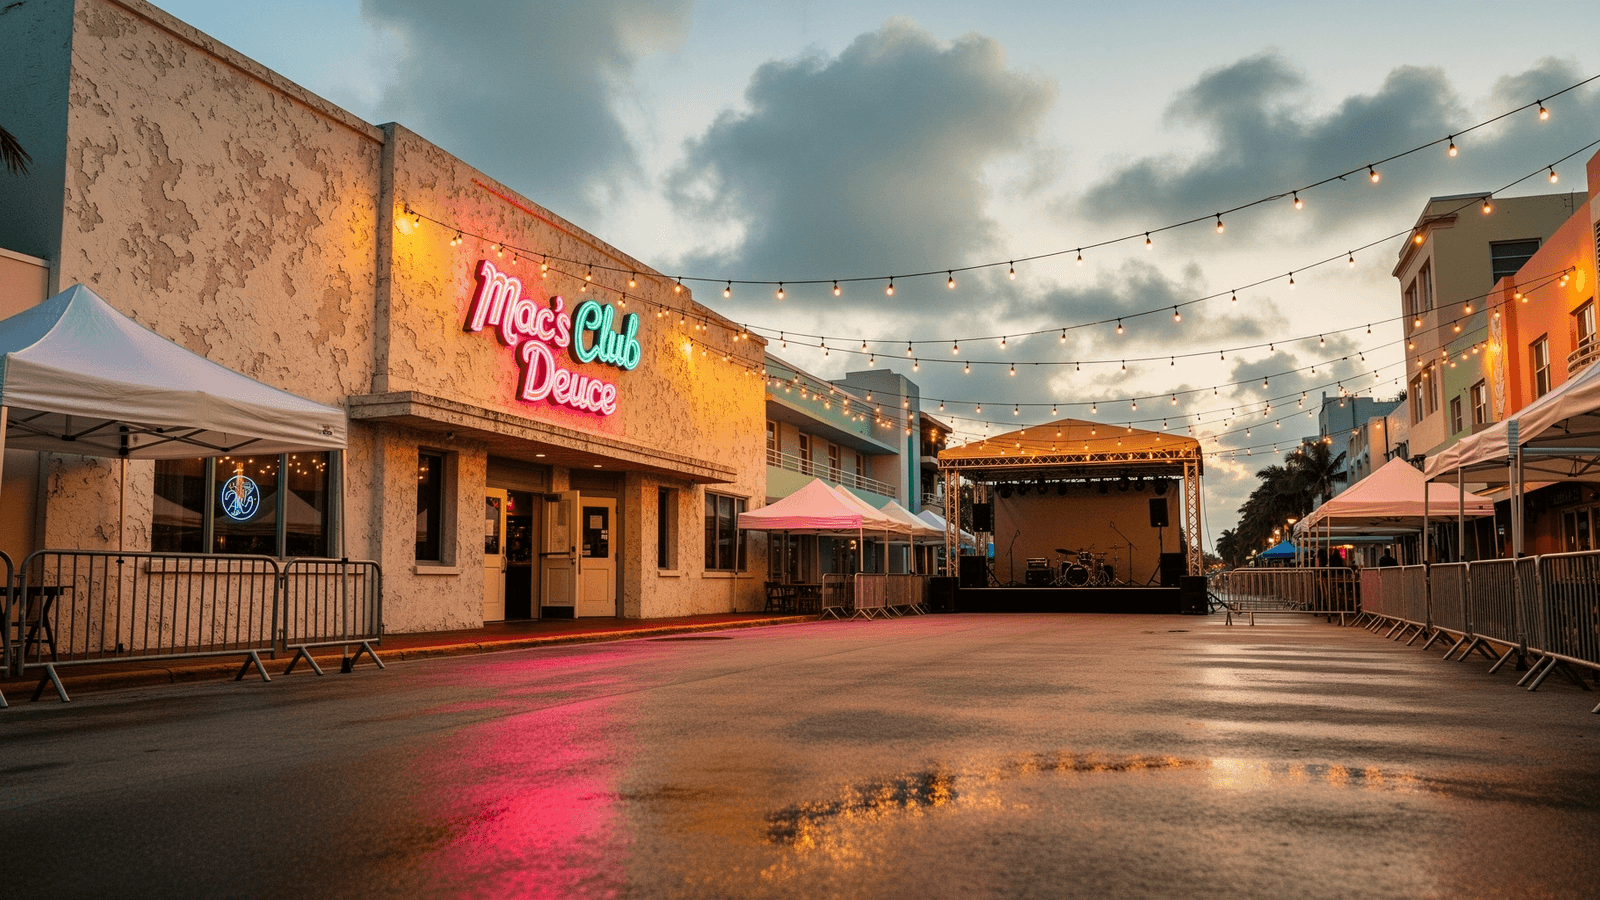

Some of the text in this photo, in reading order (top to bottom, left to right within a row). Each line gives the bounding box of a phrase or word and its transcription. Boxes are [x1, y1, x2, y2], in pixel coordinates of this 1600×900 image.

[467, 259, 641, 370] Mac's Club
[519, 340, 617, 415] Deuce
